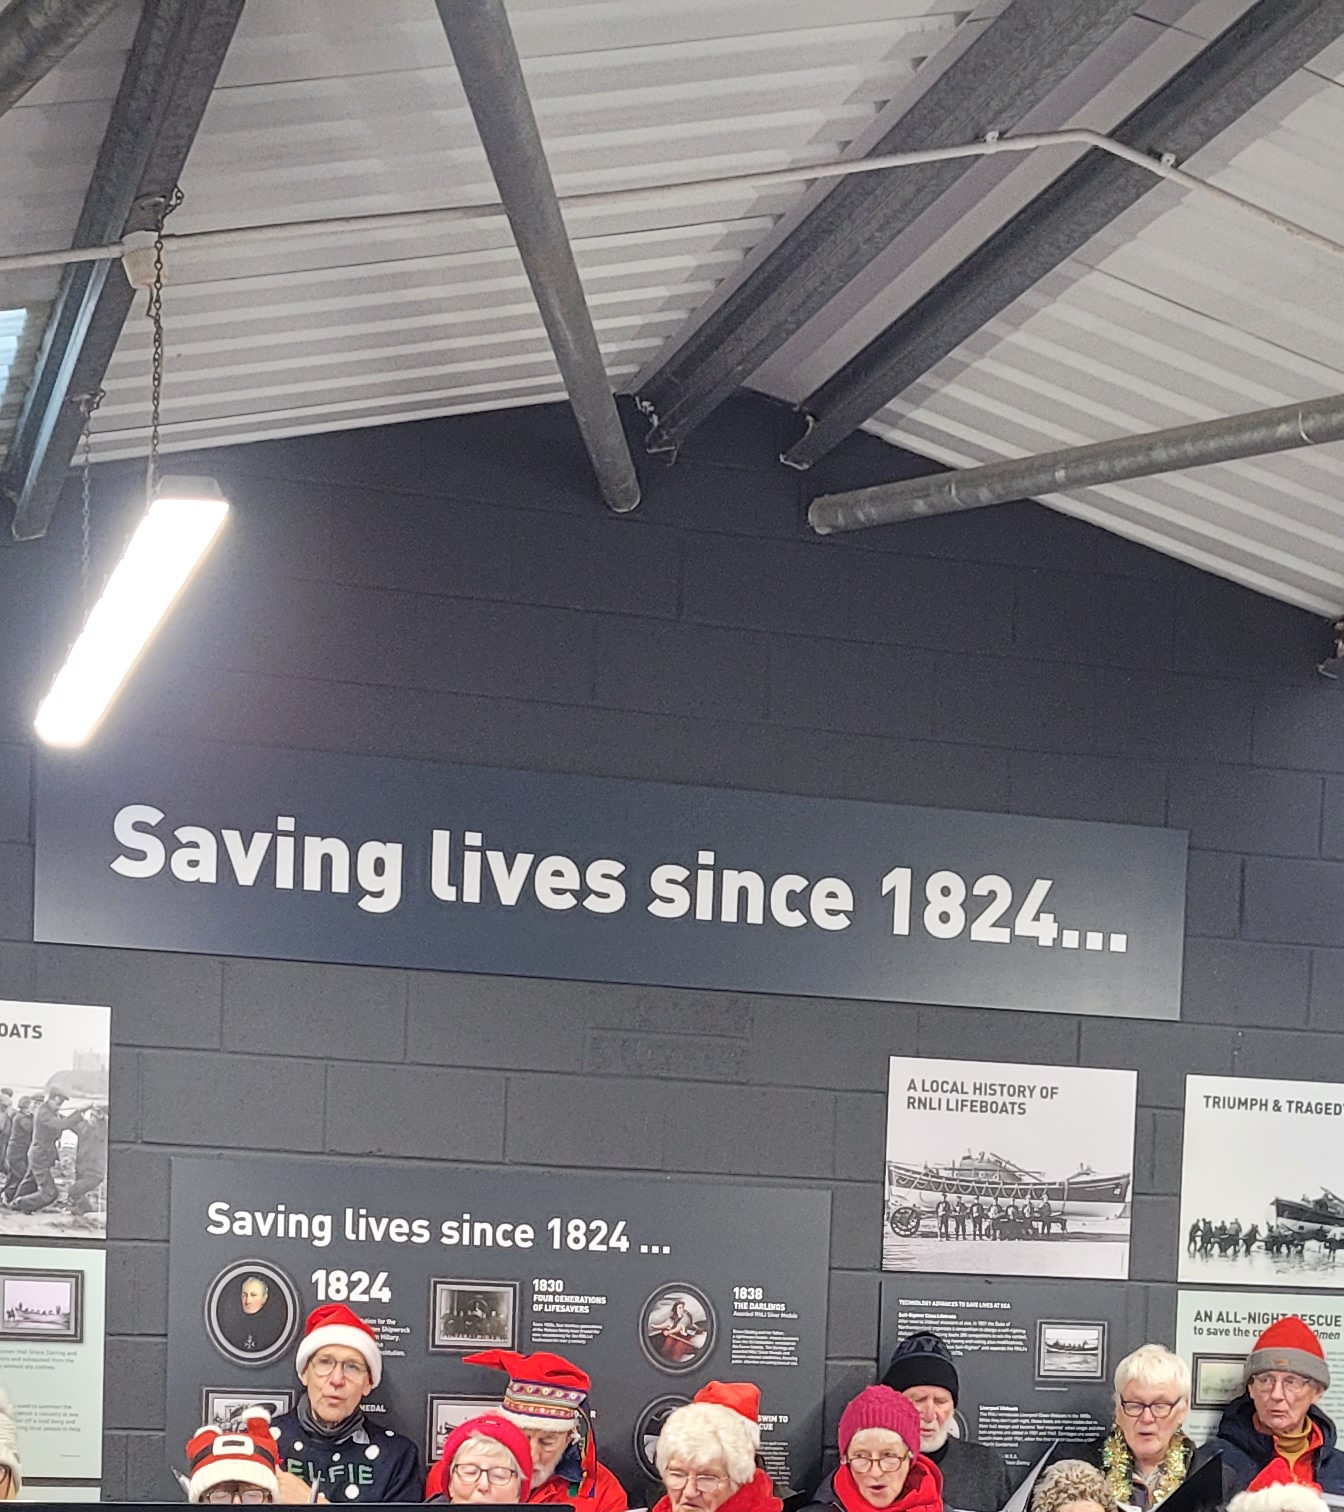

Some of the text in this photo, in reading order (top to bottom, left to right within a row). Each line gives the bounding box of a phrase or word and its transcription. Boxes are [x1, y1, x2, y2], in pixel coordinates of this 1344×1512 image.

[109, 804, 404, 913] Saving
[430, 829, 627, 915] lives
[645, 849, 854, 931] since
[906, 1078, 1059, 1100] A LOCAL HISTORY OF
[906, 1097, 1027, 1116] RNLI LIFEBOATS
[1203, 1095, 1268, 1112] TRIUMPH
[1271, 1099, 1282, 1112] &
[205, 1201, 331, 1246] Saving
[344, 1207, 429, 1244] lives
[439, 1213, 534, 1248] since
[545, 1218, 629, 1253] 1824
[310, 1268, 392, 1303] 1824
[532, 1278, 564, 1292] 1830
[533, 1294, 607, 1304] FOUR GENERATIONS
[732, 1286, 763, 1300] 1838
[544, 1304, 590, 1313] LIFESAVERS
[733, 1302, 786, 1311] THE DARLINGS
[1194, 1310, 1213, 1322] AN
[1194, 1326, 1250, 1337] to save the
